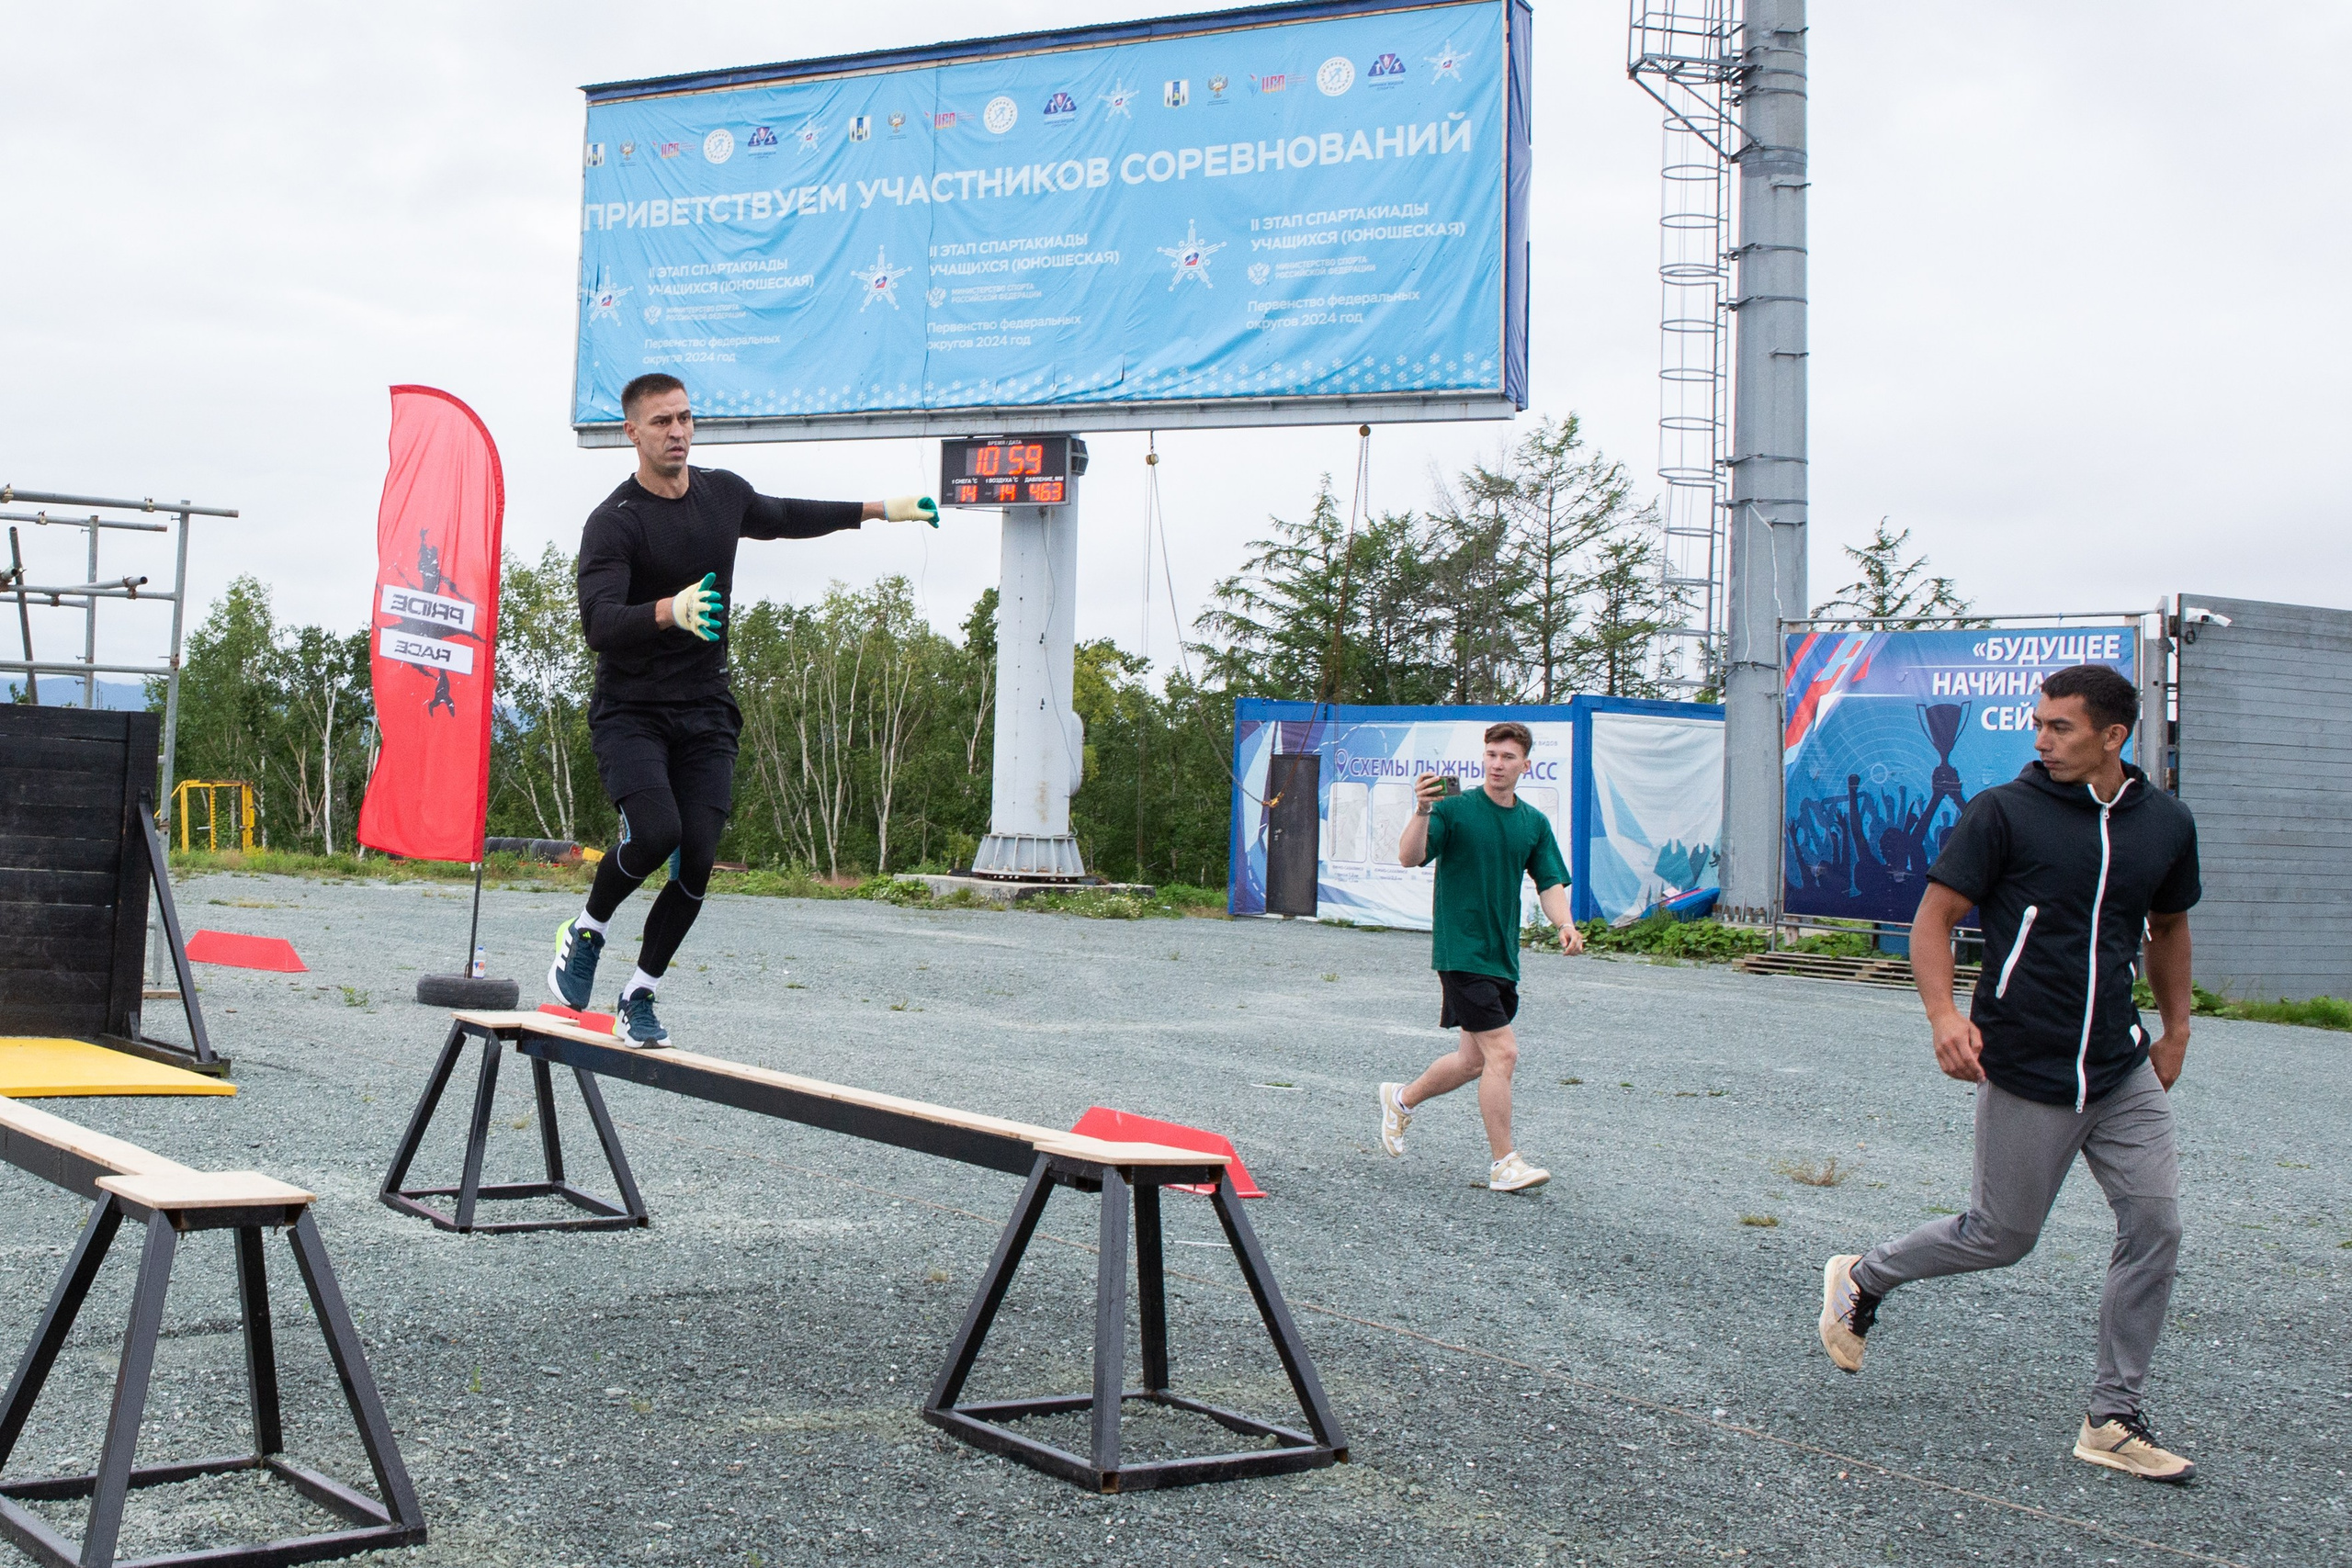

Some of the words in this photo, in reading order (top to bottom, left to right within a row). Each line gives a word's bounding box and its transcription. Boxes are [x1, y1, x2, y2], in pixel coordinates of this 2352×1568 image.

[582, 183, 847, 231] ПРИВЕТСТВУЕМ
[855, 157, 1110, 209] УЧАСТНИКОВ
[1120, 111, 1472, 185] СОРЕВНОВАНИЙ
[1262, 214, 1303, 231] ЭТАП
[1306, 202, 1429, 226] СПАРТАКИАДЫ
[940, 243, 977, 257] ЭТАП
[978, 232, 1089, 254] СПАРТАКИАДЫ
[1250, 231, 1338, 251] УЧАЩИХСЯ
[1340, 221, 1466, 245] (ЮНОШЕСКАЯ)
[658, 265, 689, 278] ЭТАП
[691, 258, 788, 276] СПАРТАКИАДЫ
[930, 258, 1009, 276] УЧАЩИХСЯ
[1011, 250, 1120, 273] (ЮНОШЕСКАЯ)
[1337, 255, 1368, 265] СПОРТА
[648, 282, 718, 296] УЧАЩИХСЯ
[720, 274, 815, 295] (ЮНОШЕСКАЯ)
[1007, 282, 1035, 291] СПОРТА
[1248, 298, 1325, 313] Первенство
[1328, 290, 1420, 309] федеральных
[927, 321, 997, 335] Первенство
[1000, 315, 1081, 331] федеральных
[1246, 317, 1299, 331] округов
[1301, 312, 1337, 326] 2024
[1340, 312, 1363, 324] год
[644, 339, 706, 350] Первенство
[707, 334, 781, 349] федеральных
[927, 339, 974, 352] округов
[976, 335, 1008, 347] 2024
[1010, 335, 1031, 347] год
[643, 354, 683, 367] округов
[684, 353, 715, 363] 2024
[717, 353, 736, 364] год
[1008, 444, 1044, 475] 59
[1973, 634, 2121, 666] «БУДУЩЕЕ
[1932, 671, 2052, 696] НАЧИНА
[1981, 701, 2038, 731] СЕЙ
[1350, 757, 1408, 777] СХЕМЫ
[1413, 760, 1485, 778] ЛЫЖНЫ
[1521, 761, 1558, 781] АСС
